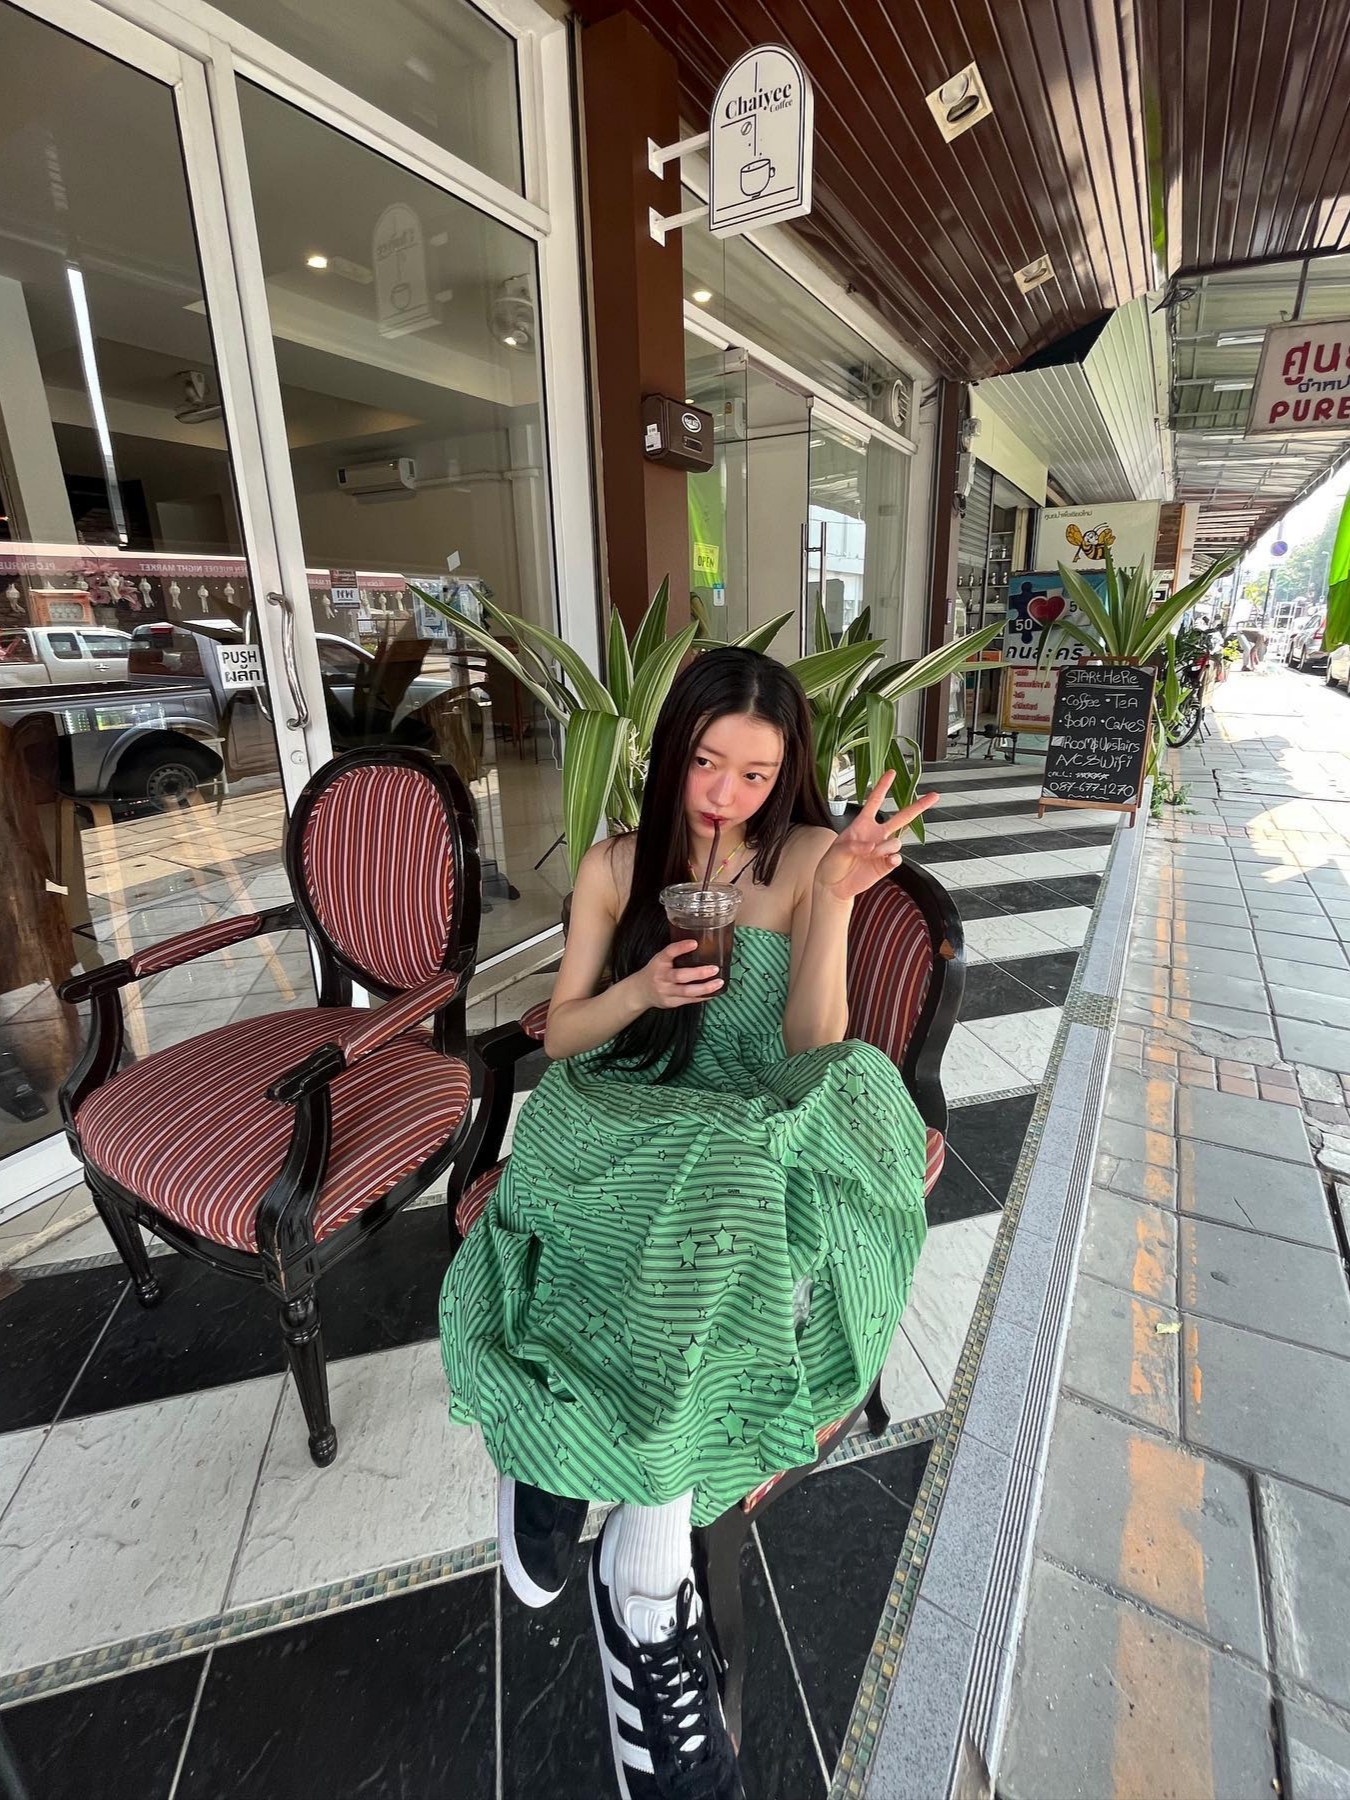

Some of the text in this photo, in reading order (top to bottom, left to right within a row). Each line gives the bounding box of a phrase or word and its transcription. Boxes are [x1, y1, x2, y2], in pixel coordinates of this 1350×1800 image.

[725, 83, 792, 120] Chaiyee
[769, 99, 794, 113] Coffee
[1282, 341, 1350, 386] ศูน
[1269, 396, 1350, 424] PURE
[697, 555, 715, 568] OPEN
[1015, 618, 1033, 631] 50
[222, 650, 257, 664] PUSH
[225, 664, 260, 682] ผลัก
[1066, 693, 1101, 710] Coffee
[1049, 781, 1135, 797] 087-677-1270
